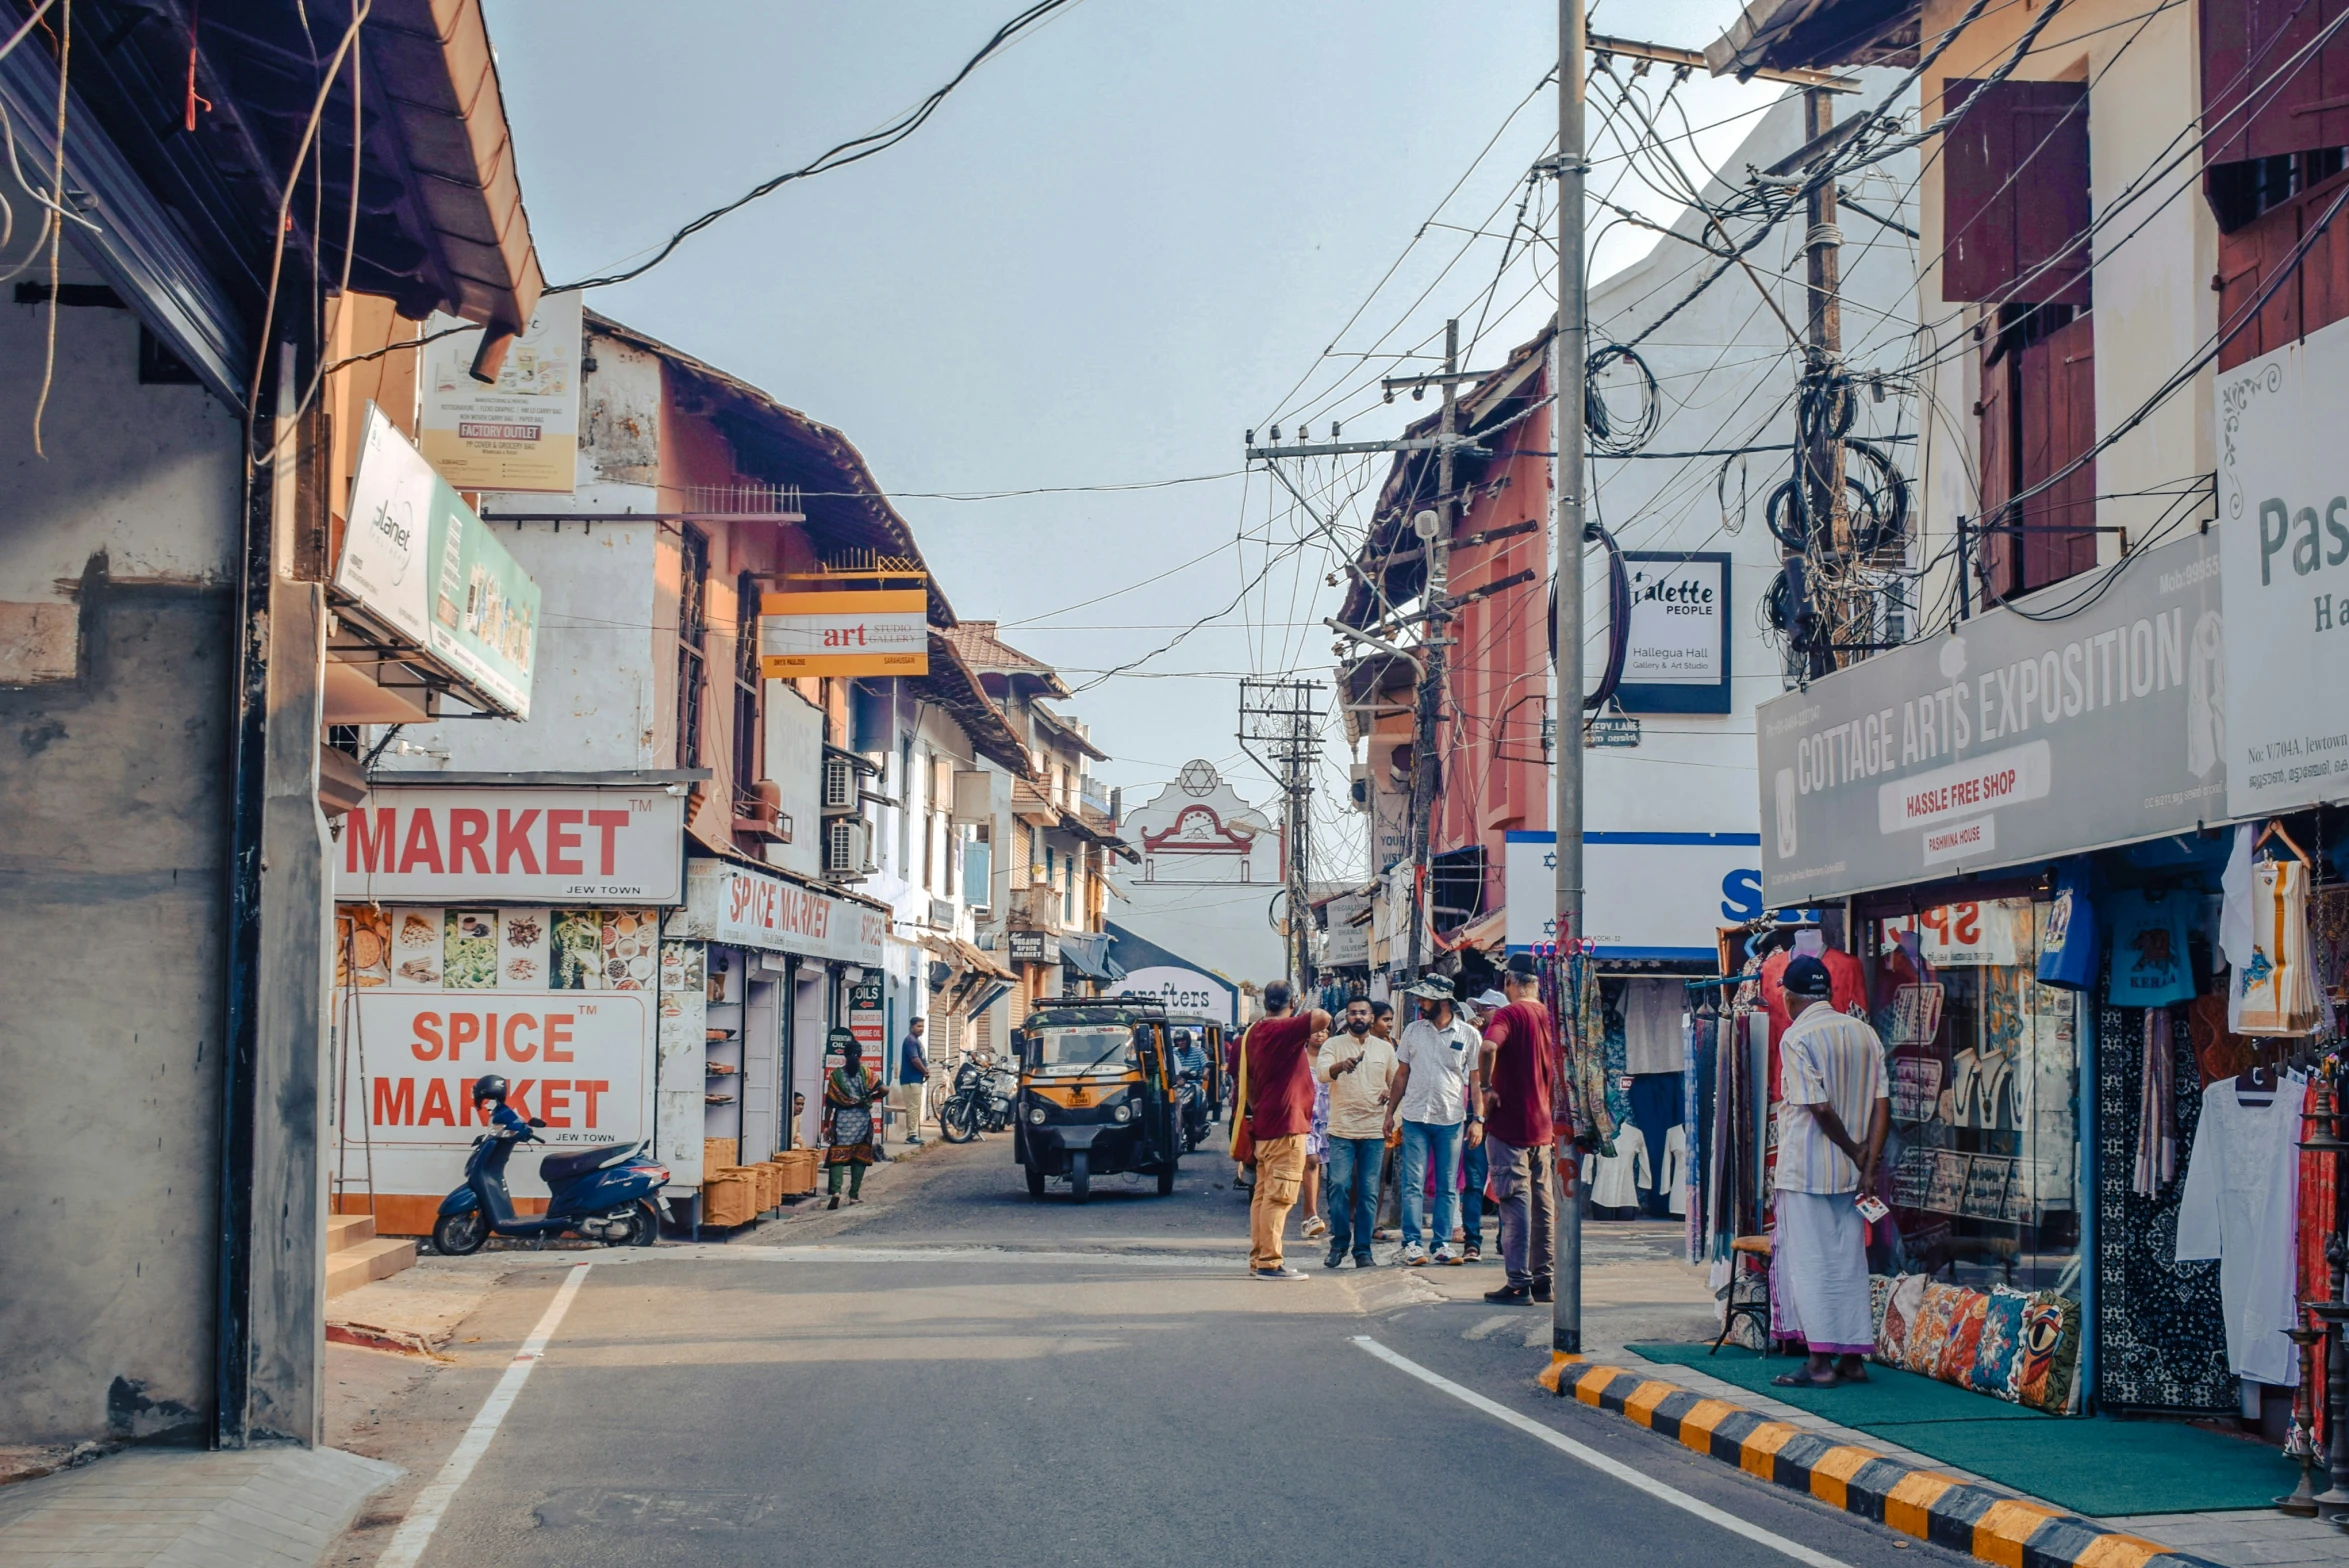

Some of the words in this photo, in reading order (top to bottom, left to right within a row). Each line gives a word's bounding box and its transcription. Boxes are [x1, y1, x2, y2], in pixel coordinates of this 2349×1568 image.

[461, 424, 503, 437] FACTORY
[504, 426, 538, 439] OUTLET
[1666, 605, 1713, 616] PEOPLE
[874, 624, 912, 634] STUDIO
[823, 622, 868, 648] art
[869, 634, 916, 644] GALLERY
[1633, 647, 1683, 660] Hallegua
[1686, 647, 1709, 658] Hall
[1632, 661, 1660, 671] Gallery
[1671, 661, 1682, 670] Art
[1684, 661, 1709, 670] Studio
[1797, 706, 1896, 796] COTTAGE
[1901, 680, 1971, 768] ARTS
[1978, 606, 2182, 745] EXPOSITION
[2305, 733, 2348, 757] Jewtown
[1906, 786, 1948, 819] HASSLE
[1951, 778, 1980, 808] FREE
[1983, 768, 2016, 800] SHOP
[345, 807, 630, 877] MARKET
[1928, 831, 1959, 853] PASHMINA
[1959, 825, 1981, 846] HOUSE
[567, 885, 596, 895] JEW
[600, 885, 642, 895] TOWN
[729, 875, 777, 929] SPICE
[778, 887, 831, 940] MARKET
[860, 912, 882, 947] SPICES
[1337, 928, 1363, 937] SHAWLS
[1012, 937, 1042, 946] ORGANIC
[1593, 934, 1611, 943] KOCHI
[1341, 944, 1362, 952] SILVER
[1012, 951, 1042, 959] MARKET
[855, 986, 879, 1000] OILS
[578, 1004, 598, 1015] TM
[410, 1011, 575, 1063] SPICE
[830, 1034, 852, 1042] ESSENTIA
[873, 1029, 882, 1038] OIL
[871, 1045, 882, 1053] OIL
[555, 1133, 579, 1142] JEW
[582, 1133, 615, 1143] TOWN
